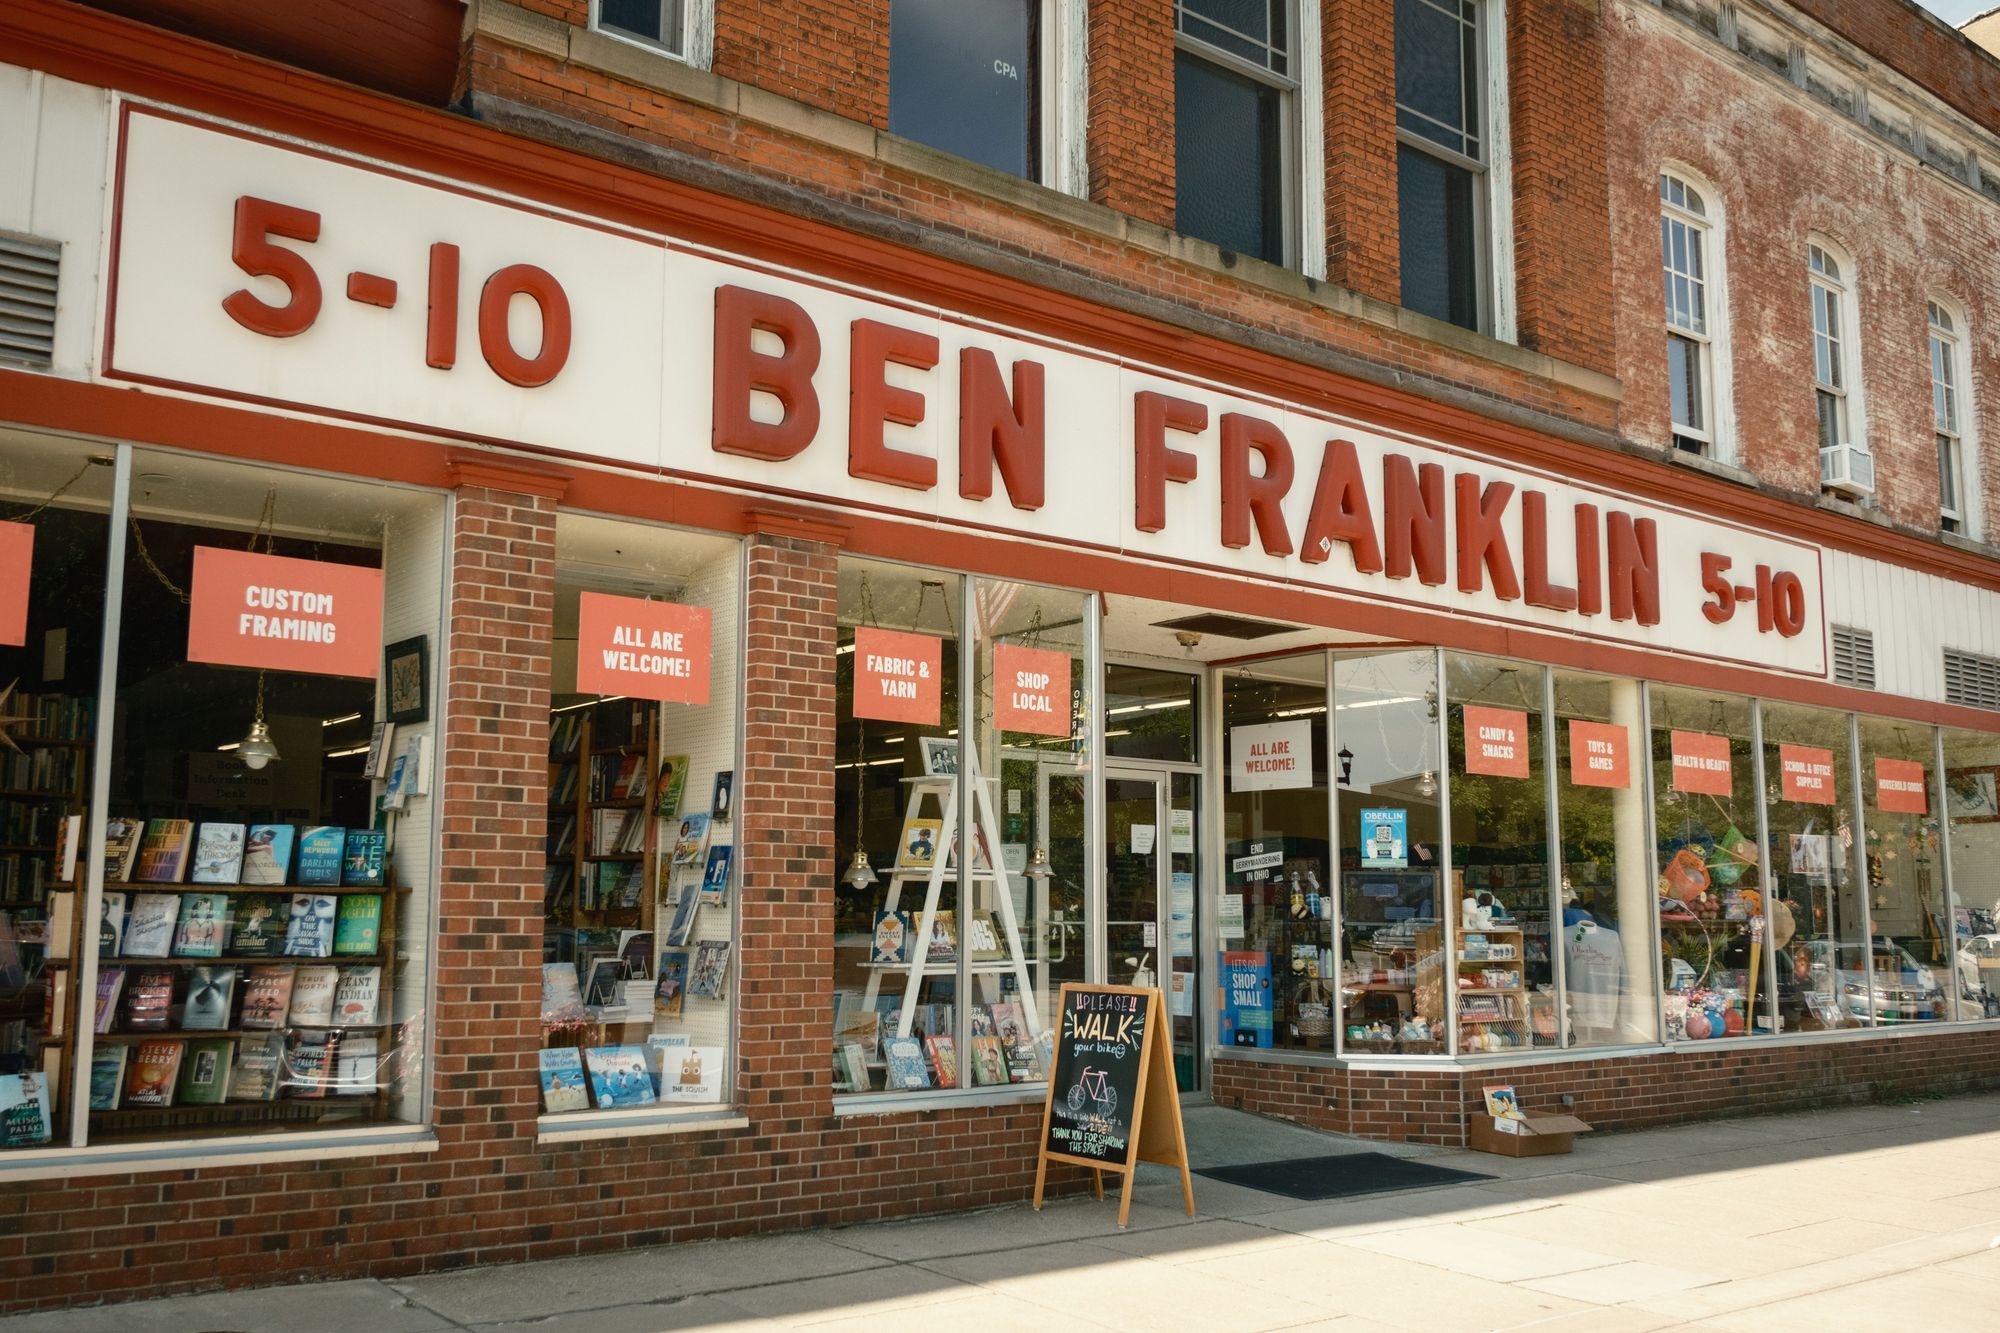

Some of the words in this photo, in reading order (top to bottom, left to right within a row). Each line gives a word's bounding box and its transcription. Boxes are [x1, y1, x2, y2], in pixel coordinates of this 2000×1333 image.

[994, 59, 1018, 80] CPA
[222, 195, 572, 388] 5-10
[712, 283, 1045, 511] BEN
[1134, 390, 1660, 627] FRANKLIN
[1701, 551, 1805, 637] 5-10
[245, 585, 333, 615] CUSTOM
[239, 613, 336, 644] FRAMING
[612, 625, 646, 648] ALL
[650, 630, 684, 652] ARE
[602, 649, 692, 678] WELCOME!
[867, 654, 915, 677] FABRIC
[919, 661, 930, 679] &
[1016, 671, 1050, 690] SHOP
[880, 678, 917, 699] YARN
[1012, 692, 1053, 713] LOCAL
[1479, 726, 1506, 742] CANDY
[1507, 729, 1515, 743] &
[1250, 743, 1268, 756] ALL
[1271, 741, 1290, 755] ARE
[1482, 743, 1514, 759] SNACKS
[1586, 740, 1606, 754] TOYS
[1606, 742, 1614, 755] &
[1245, 757, 1296, 773] WELCOME!
[1588, 757, 1613, 770] GAMES
[1796, 775, 1822, 789] SUPPLIES
[1364, 812, 1403, 820] OBERLIN
[347, 835, 385, 844] FIRST
[345, 846, 382, 861] LIE
[1250, 843, 1264, 854] END
[301, 859, 338, 868] DARLING
[344, 862, 381, 871] WINS
[1235, 854, 1281, 870] GERRYMANDERING
[306, 869, 331, 877] GIRLS
[1246, 871, 1253, 882] IN
[1253, 869, 1270, 881] OHIO
[304, 914, 316, 922] ON
[1232, 959, 1247, 973] LET'S
[1248, 959, 1257, 972] GO
[251, 978, 288, 987] PEACH
[302, 975, 325, 983] TRUE
[345, 977, 372, 987] EAST
[1232, 973, 1257, 990] SHOP
[129, 986, 170, 996] BROKEN
[254, 988, 280, 997] SEED
[297, 983, 329, 991] NORTH
[340, 990, 374, 1001] INDIAN
[1233, 990, 1262, 1007] SMALL
[1073, 1013, 1135, 1044] WALK
[142, 1045, 175, 1055] STEVE
[1073, 1043, 1095, 1057] your
[1096, 1043, 1116, 1053] bike
[138, 1055, 173, 1065] BERRY
[10, 1121, 43, 1135] PATAKI
[1052, 1127, 1071, 1139] THANK
[1071, 1129, 1083, 1141] YOU
[1084, 1132, 1098, 1143] FOR
[1098, 1134, 1125, 1150] SHARING
[1069, 1141, 1083, 1152] THE
[1083, 1142, 1107, 1156] SPACE!
